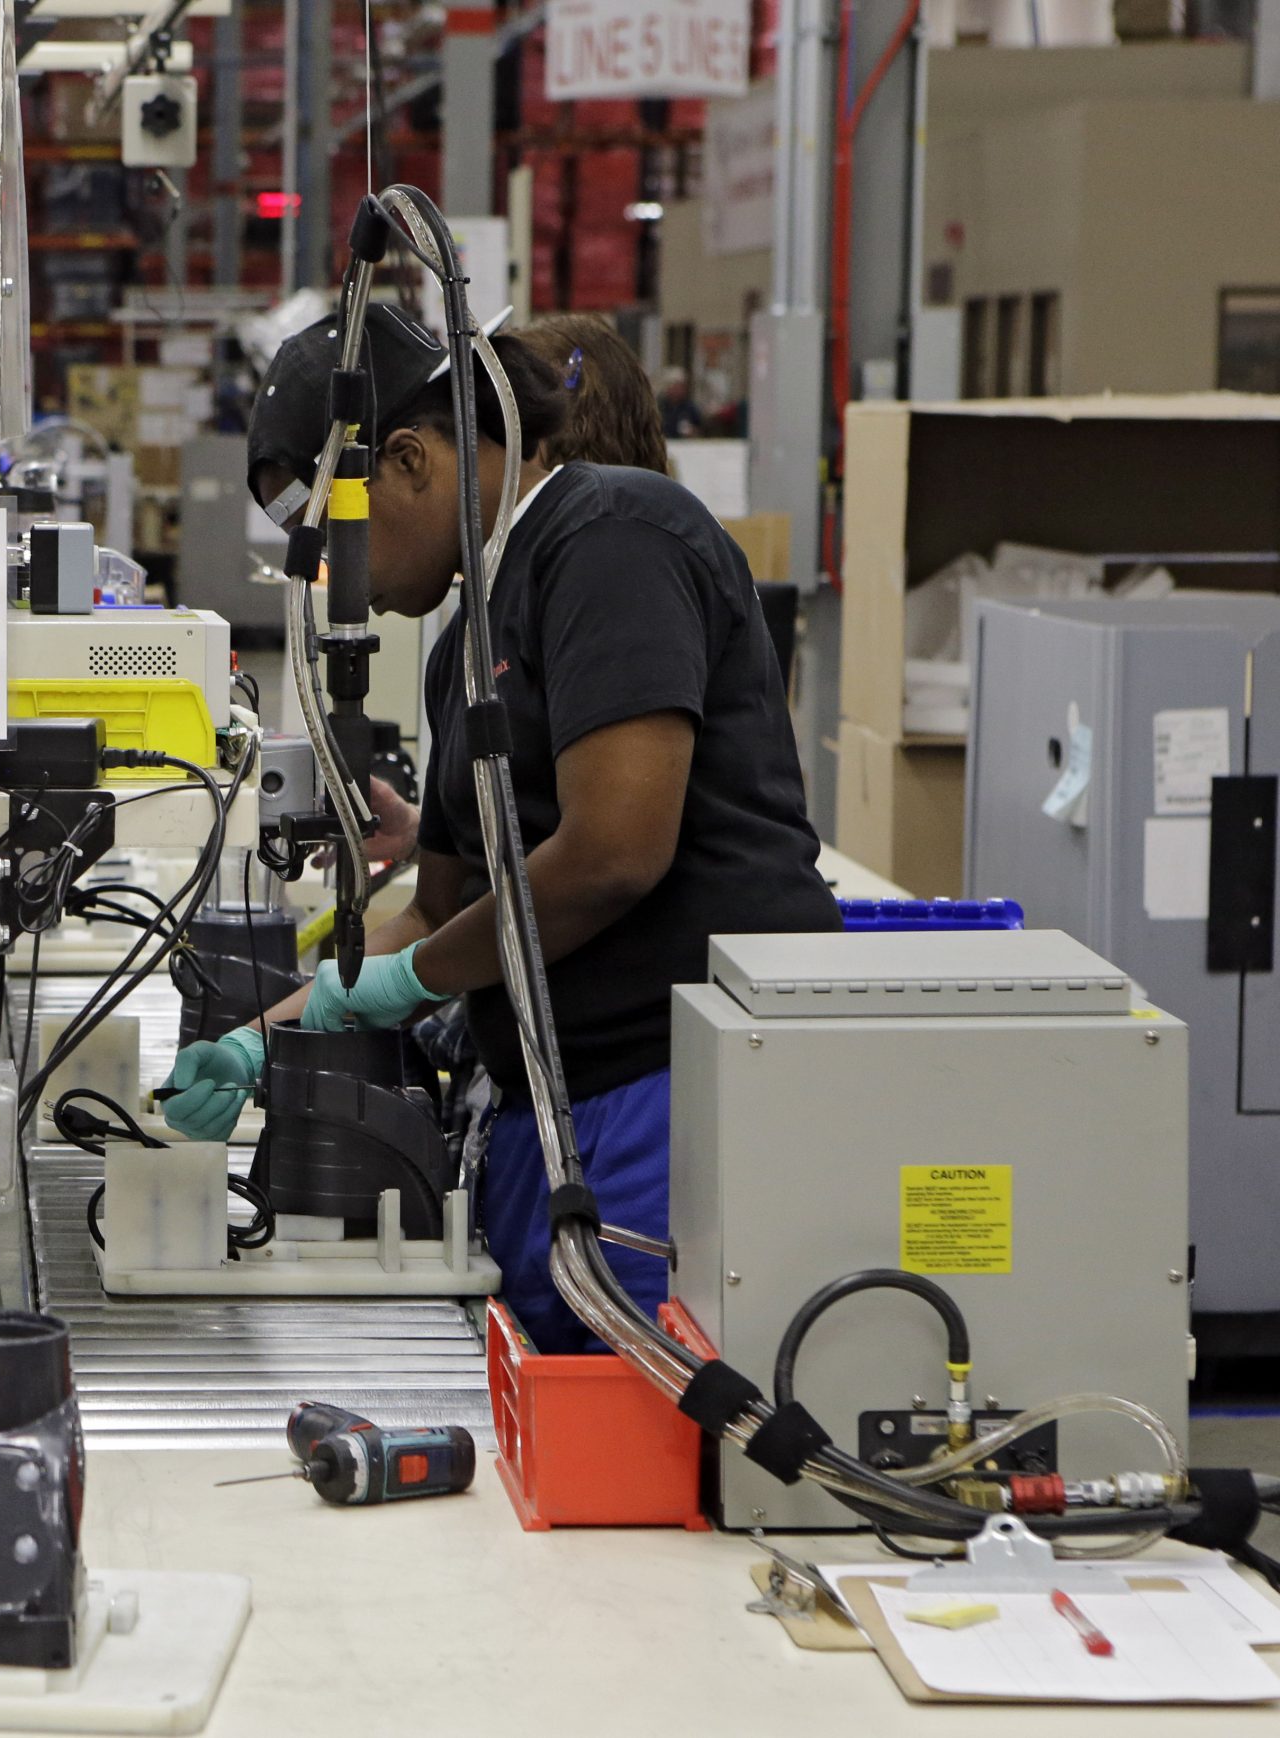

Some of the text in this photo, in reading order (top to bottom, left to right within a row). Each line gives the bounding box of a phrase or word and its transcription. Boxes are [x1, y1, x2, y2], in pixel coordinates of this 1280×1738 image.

[554, 17, 631, 86] LINE
[640, 12, 663, 78] 5
[930, 1169, 986, 1180] CAUTION
